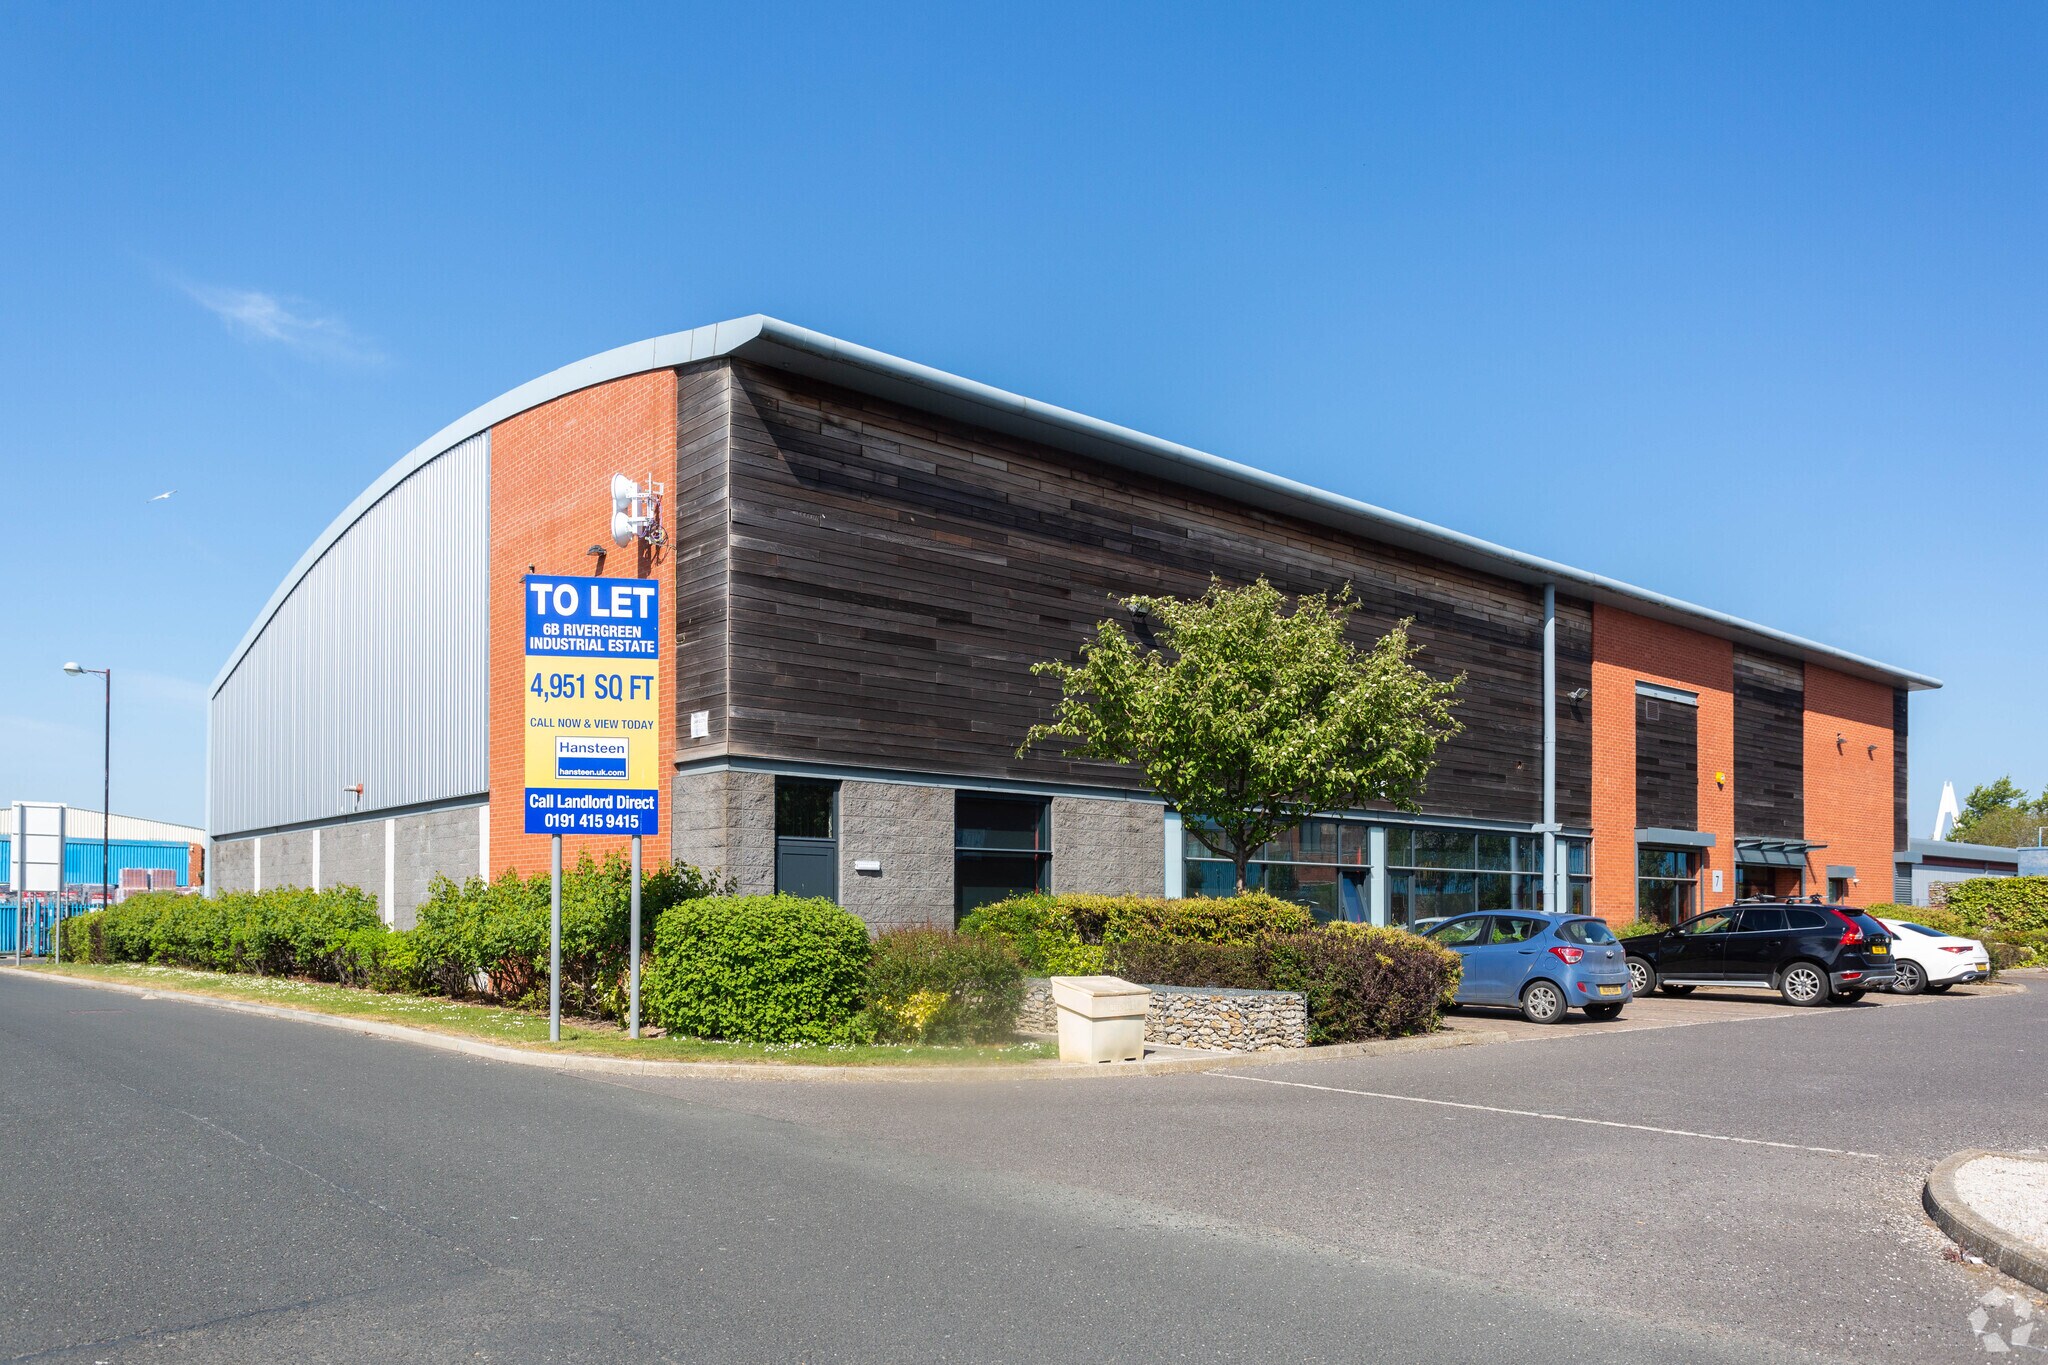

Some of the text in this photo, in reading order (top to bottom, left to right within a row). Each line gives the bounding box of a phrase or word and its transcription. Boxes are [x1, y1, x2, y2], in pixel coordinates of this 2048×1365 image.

[530, 583, 655, 619] TO LET
[543, 623, 642, 639] 6B RIVERGREEN
[529, 637, 655, 653] INDUSTRIAL ESTATE
[530, 672, 654, 703] 4,951 SQ FT
[530, 717, 654, 730] CALL NOW & VIEW TODAY
[559, 741, 625, 754] Hansteen
[559, 767, 625, 777] hansteen.uk.com
[529, 794, 655, 810] Call Landlord Direct
[544, 813, 639, 829] 0191 415 9415
